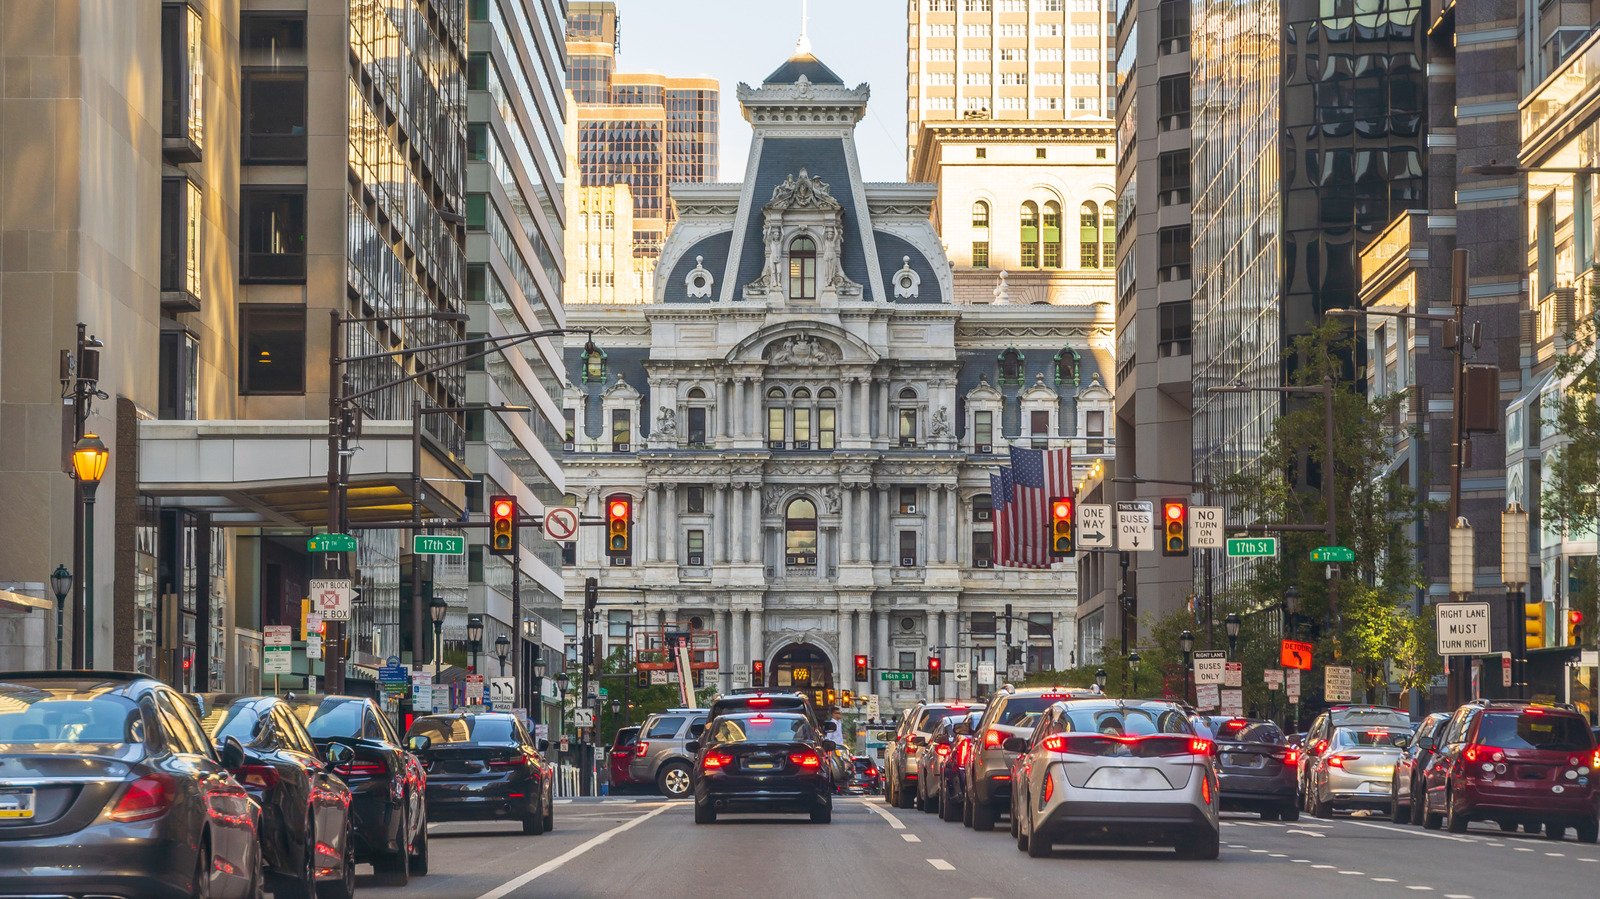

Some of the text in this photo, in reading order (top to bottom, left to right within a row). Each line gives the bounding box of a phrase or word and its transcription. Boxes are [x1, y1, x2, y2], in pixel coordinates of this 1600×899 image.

[1134, 503, 1151, 511] LANE
[1083, 508, 1104, 518] ONE
[1198, 511, 1215, 520] NO
[1120, 514, 1150, 523] BUSES
[1083, 520, 1105, 529] WAY
[1122, 525, 1147, 534] ONLY
[1200, 529, 1212, 537] ON
[423, 539, 455, 551] 17th St
[1197, 537, 1215, 545] RED
[1236, 541, 1267, 553] 17th St
[330, 581, 349, 589] BLOCK
[314, 610, 348, 618] HE BOX
[1440, 609, 1486, 619] RIGHT LANE
[1449, 624, 1477, 634] MUST
[1284, 642, 1312, 652] DETOUR
[1441, 639, 1487, 649] TURN RIGHT
[1198, 662, 1222, 670] BUSES
